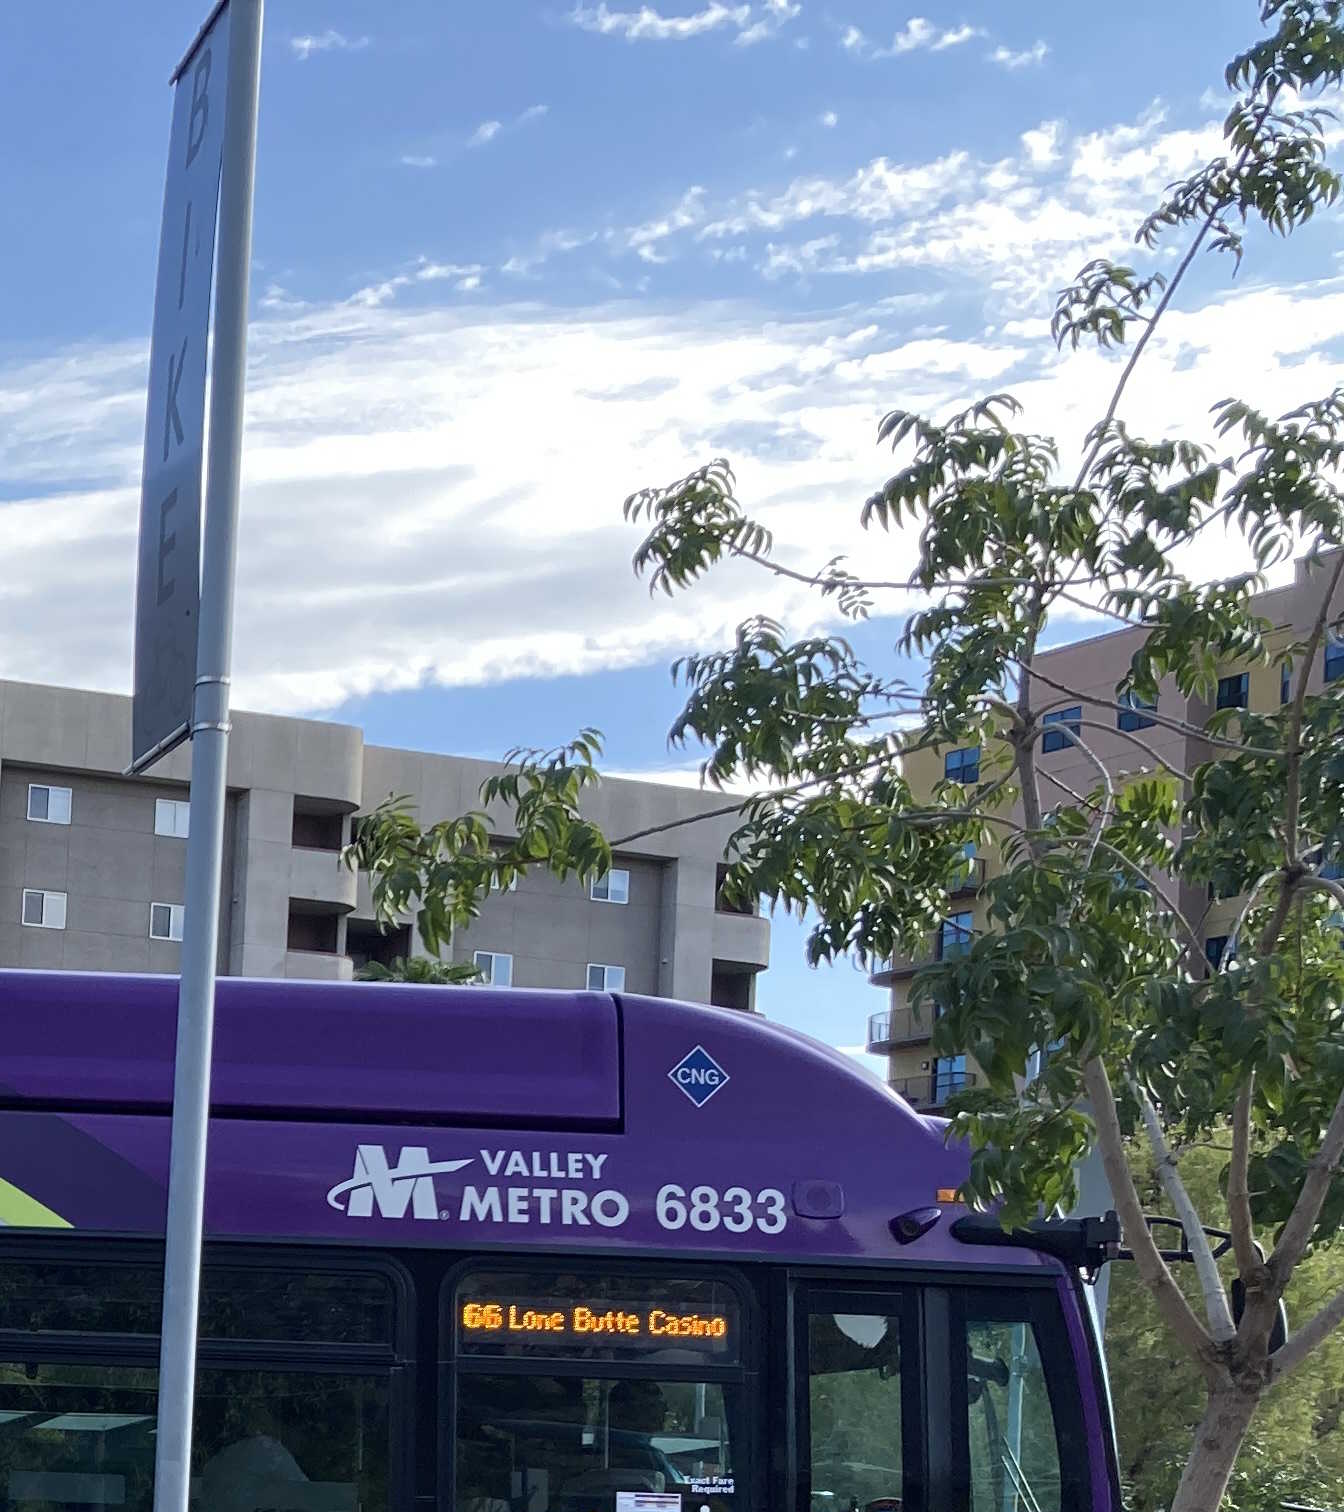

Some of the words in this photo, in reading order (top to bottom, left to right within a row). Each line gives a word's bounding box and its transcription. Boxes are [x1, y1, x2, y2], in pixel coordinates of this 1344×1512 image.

[157, 47, 212, 607] BIKE
[677, 1067, 720, 1085] CNG
[479, 1149, 609, 1181] VALLEY
[459, 1186, 630, 1228] METRO
[656, 1183, 788, 1235] 6833
[463, 1303, 503, 1329] 66
[509, 1305, 565, 1331] Lone
[573, 1306, 640, 1333] Butte
[648, 1310, 727, 1337] Casino
[691, 1485, 735, 1494] Required
[713, 1476, 734, 1485] Fare
